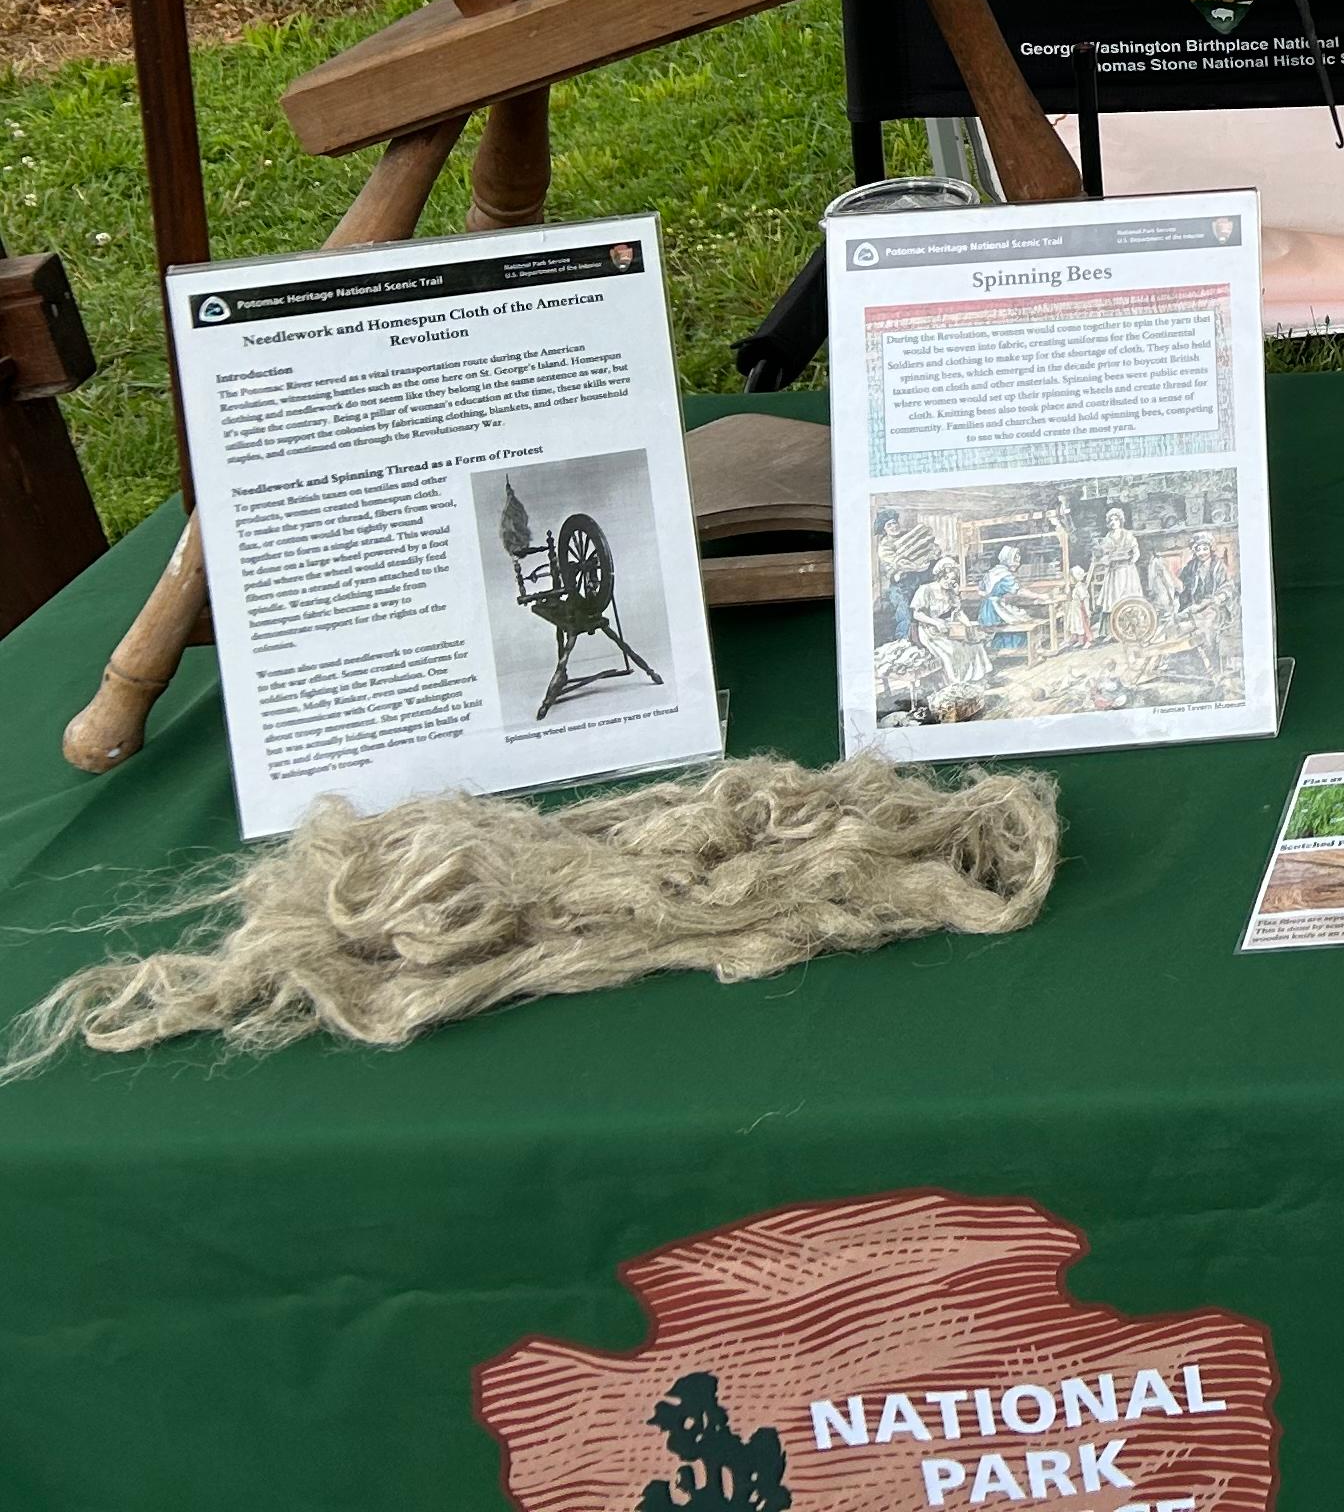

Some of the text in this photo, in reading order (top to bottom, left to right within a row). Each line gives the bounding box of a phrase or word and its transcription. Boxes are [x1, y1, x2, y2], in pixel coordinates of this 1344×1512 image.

[1186, 37, 1268, 55] Birthplace
[1097, 59, 1147, 73] homas
[1150, 57, 1198, 71] Stone
[1202, 55, 1268, 70] National
[1273, 53, 1336, 68] Histoic
[885, 236, 1063, 257] Potomac Heritage National Scenic Trail
[972, 265, 1113, 292] Spinning Bees
[236, 275, 443, 310] Potomac Heritage National Scenic Trail
[242, 293, 604, 347] Needlework and Homespun Cloth of the American
[389, 328, 470, 347] Revolution
[215, 367, 294, 384] Introduction
[231, 445, 544, 498] Needlework and Spinning Thread as a Form of Protest
[1302, 778, 1328, 786] Flax
[810, 1365, 1226, 1451] NATIONAL
[920, 1439, 1136, 1506] PARK
